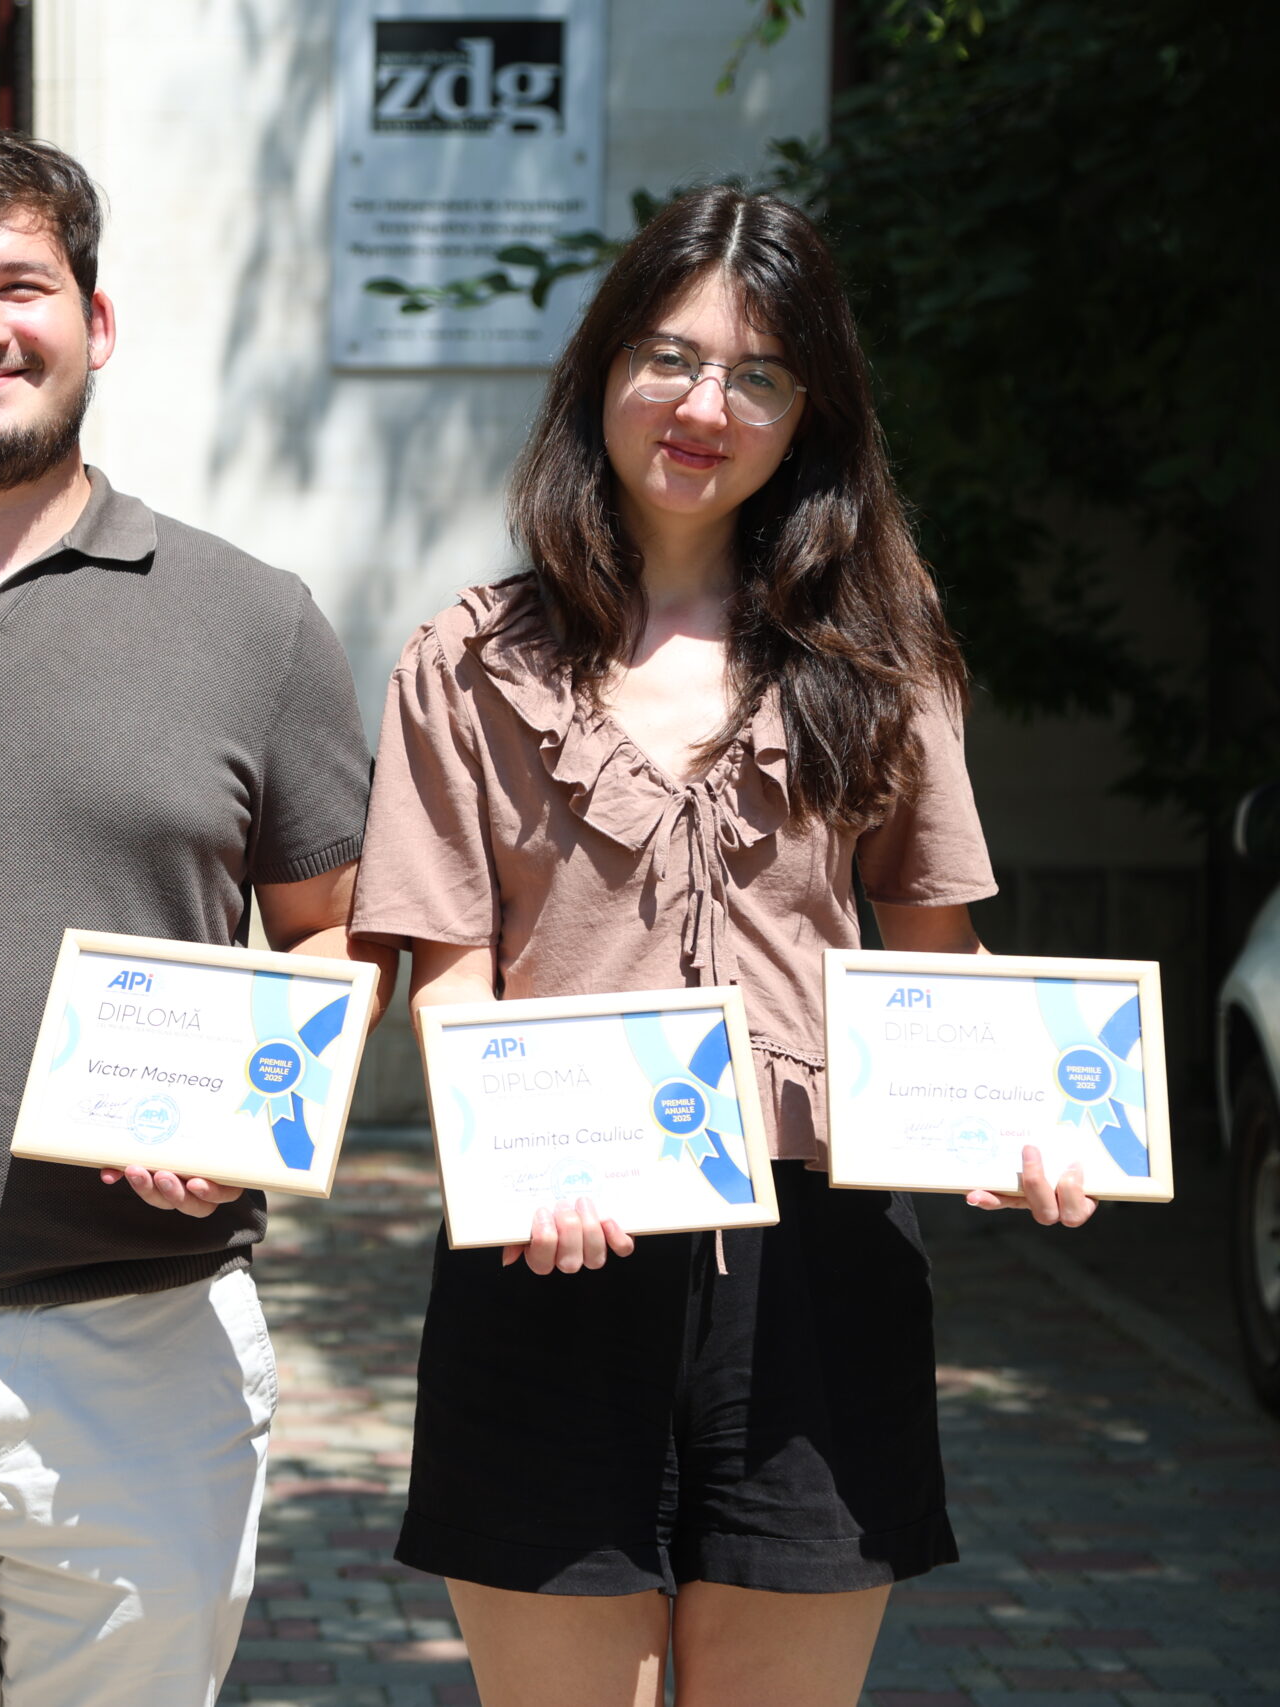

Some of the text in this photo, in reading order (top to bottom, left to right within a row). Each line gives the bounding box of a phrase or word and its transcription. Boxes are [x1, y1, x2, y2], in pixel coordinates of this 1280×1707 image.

[375, 36, 563, 137] zdg
[97, 1001, 202, 1032] DIPLOMĂ
[884, 1021, 996, 1045] DIPLOMĂ
[259, 1057, 293, 1068] PREMIILE
[87, 1058, 225, 1093] Victor Moșneag
[258, 1065, 290, 1076] ANUALE
[1065, 1065, 1102, 1075] PREMIILE
[263, 1073, 284, 1083] 2025
[482, 1065, 592, 1095] DIPLOMĂ
[1069, 1073, 1101, 1082] ANUALE
[1076, 1081, 1096, 1090] 2025
[888, 1081, 1045, 1103] Luminița Cauliuc
[661, 1097, 696, 1108] PREMIILE
[664, 1105, 696, 1115] ANUALE
[672, 1113, 692, 1123] 2025
[494, 1126, 645, 1153] Luminița Cauliuc
[604, 1168, 641, 1179] Locul III
